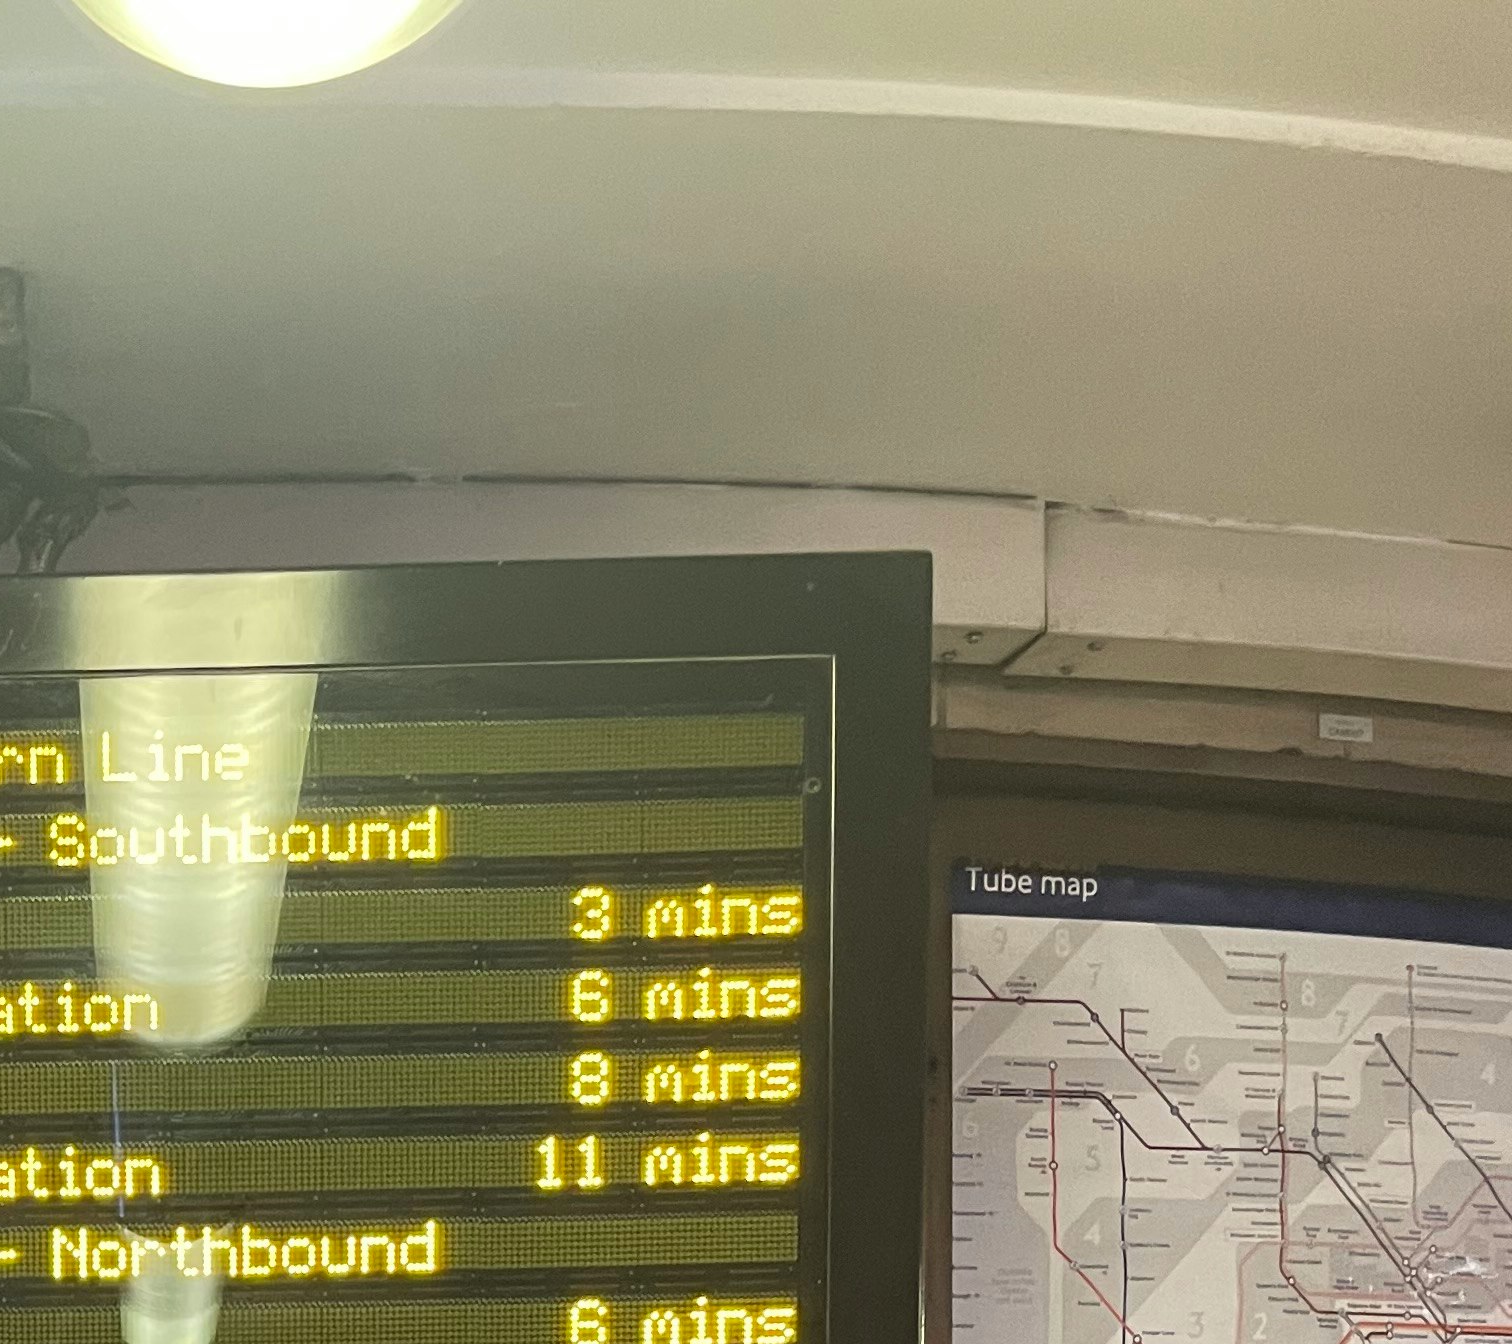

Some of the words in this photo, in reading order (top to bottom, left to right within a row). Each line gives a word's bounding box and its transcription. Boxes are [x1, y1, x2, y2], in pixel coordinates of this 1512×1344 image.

[100, 728, 253, 785] Line
[47, 804, 443, 868] Southbound
[571, 886, 612, 941] 3
[645, 882, 802, 940] mins
[965, 867, 1032, 893] Tube
[1041, 875, 1098, 902] map
[569, 969, 611, 1024] 6
[642, 965, 802, 1021] mins
[569, 1050, 612, 1107] 8
[643, 1048, 801, 1104] mins
[1185, 1044, 1201, 1072] 6
[535, 1134, 605, 1190] 11
[643, 1130, 800, 1187] mins
[51, 1219, 438, 1280] Northbound
[1187, 1311, 1205, 1339] 3
[1252, 1313, 1268, 1340] 2
